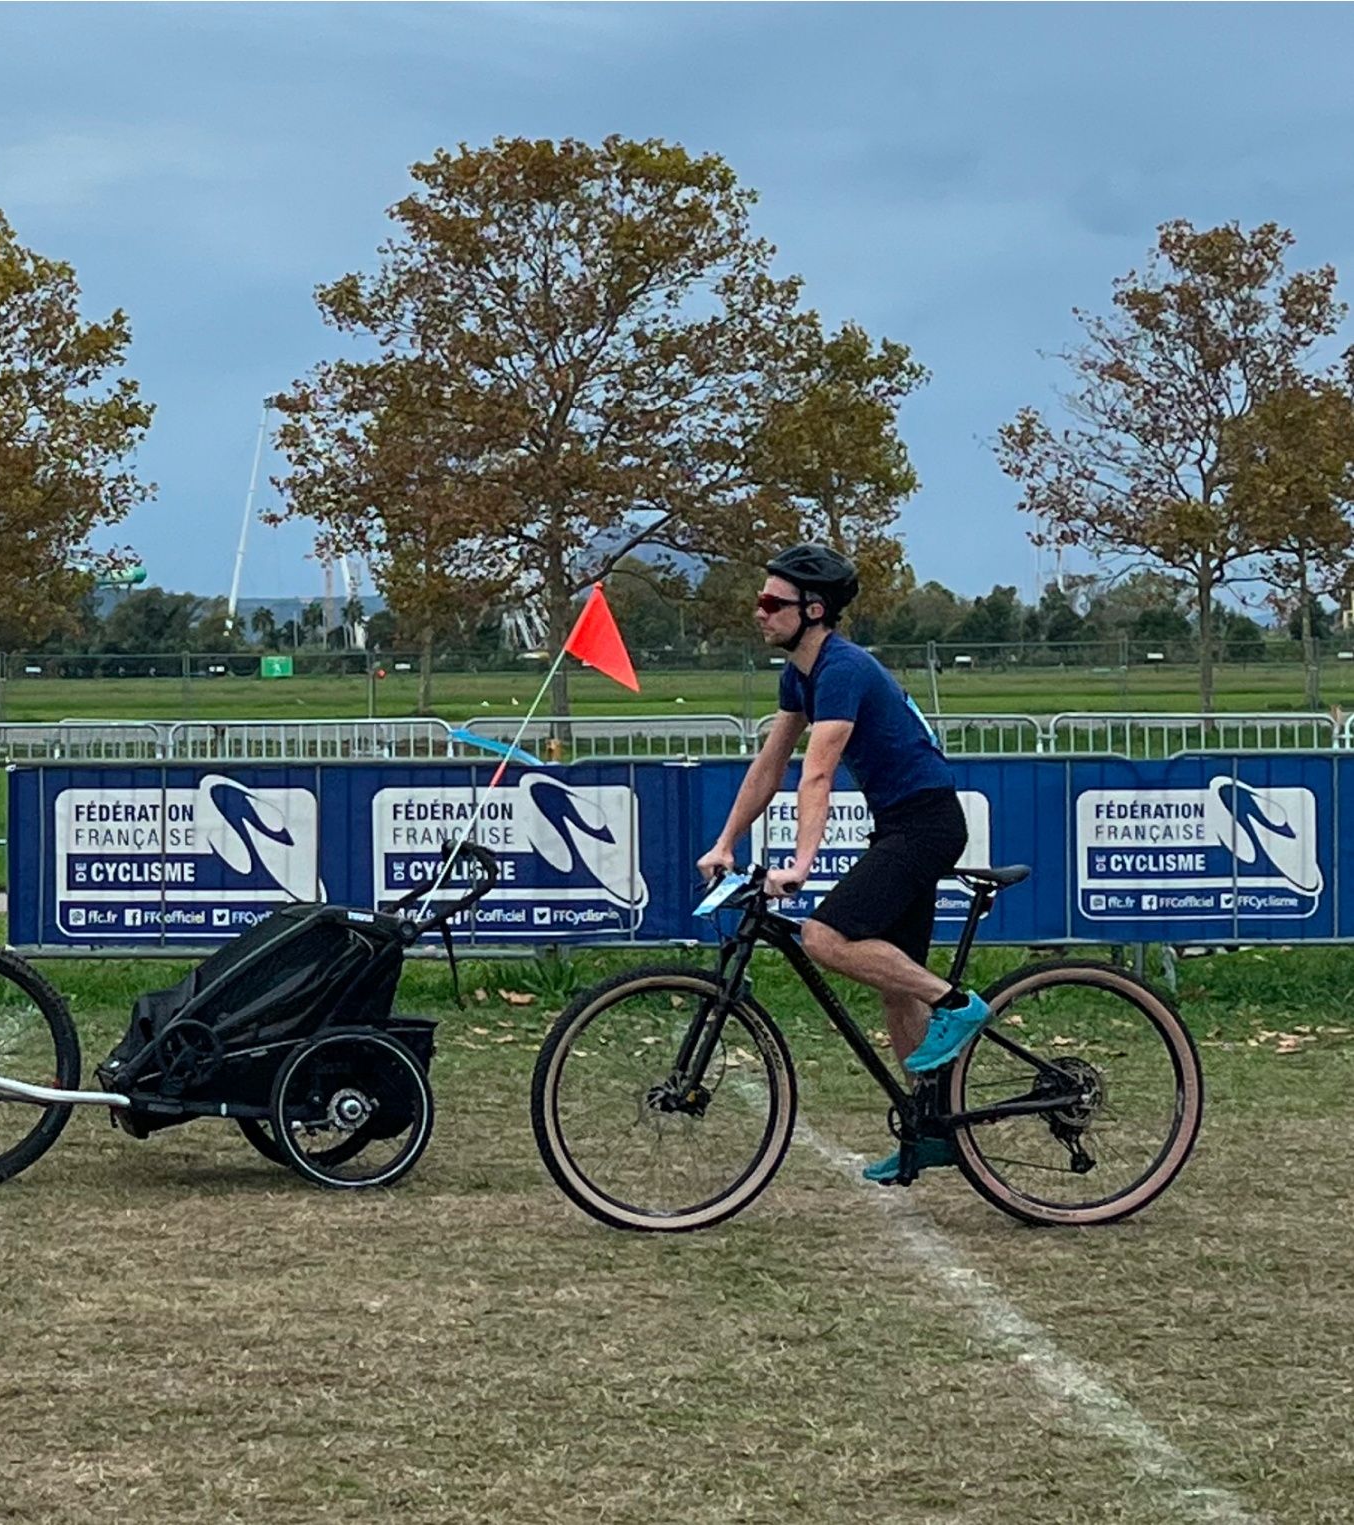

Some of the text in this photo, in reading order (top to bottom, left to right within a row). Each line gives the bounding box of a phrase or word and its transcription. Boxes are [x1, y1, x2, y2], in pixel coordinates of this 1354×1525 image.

[74, 800, 194, 822] FÉDÉRATON
[1095, 801, 1205, 819] FÉDÉRATION
[75, 828, 195, 850] FRANÇASE
[769, 827, 875, 846] FRÇAIS
[1095, 824, 1206, 843] FRANÇAISE
[74, 862, 195, 882] DE CYCLISME
[393, 861, 406, 881] DE
[1095, 854, 1206, 872] DE CYCLISME
[935, 897, 971, 909] clisme
[1108, 895, 1298, 910] ffc.fr FFCofficiel FFCyclisme
[88, 910, 118, 924] ffc.fr
